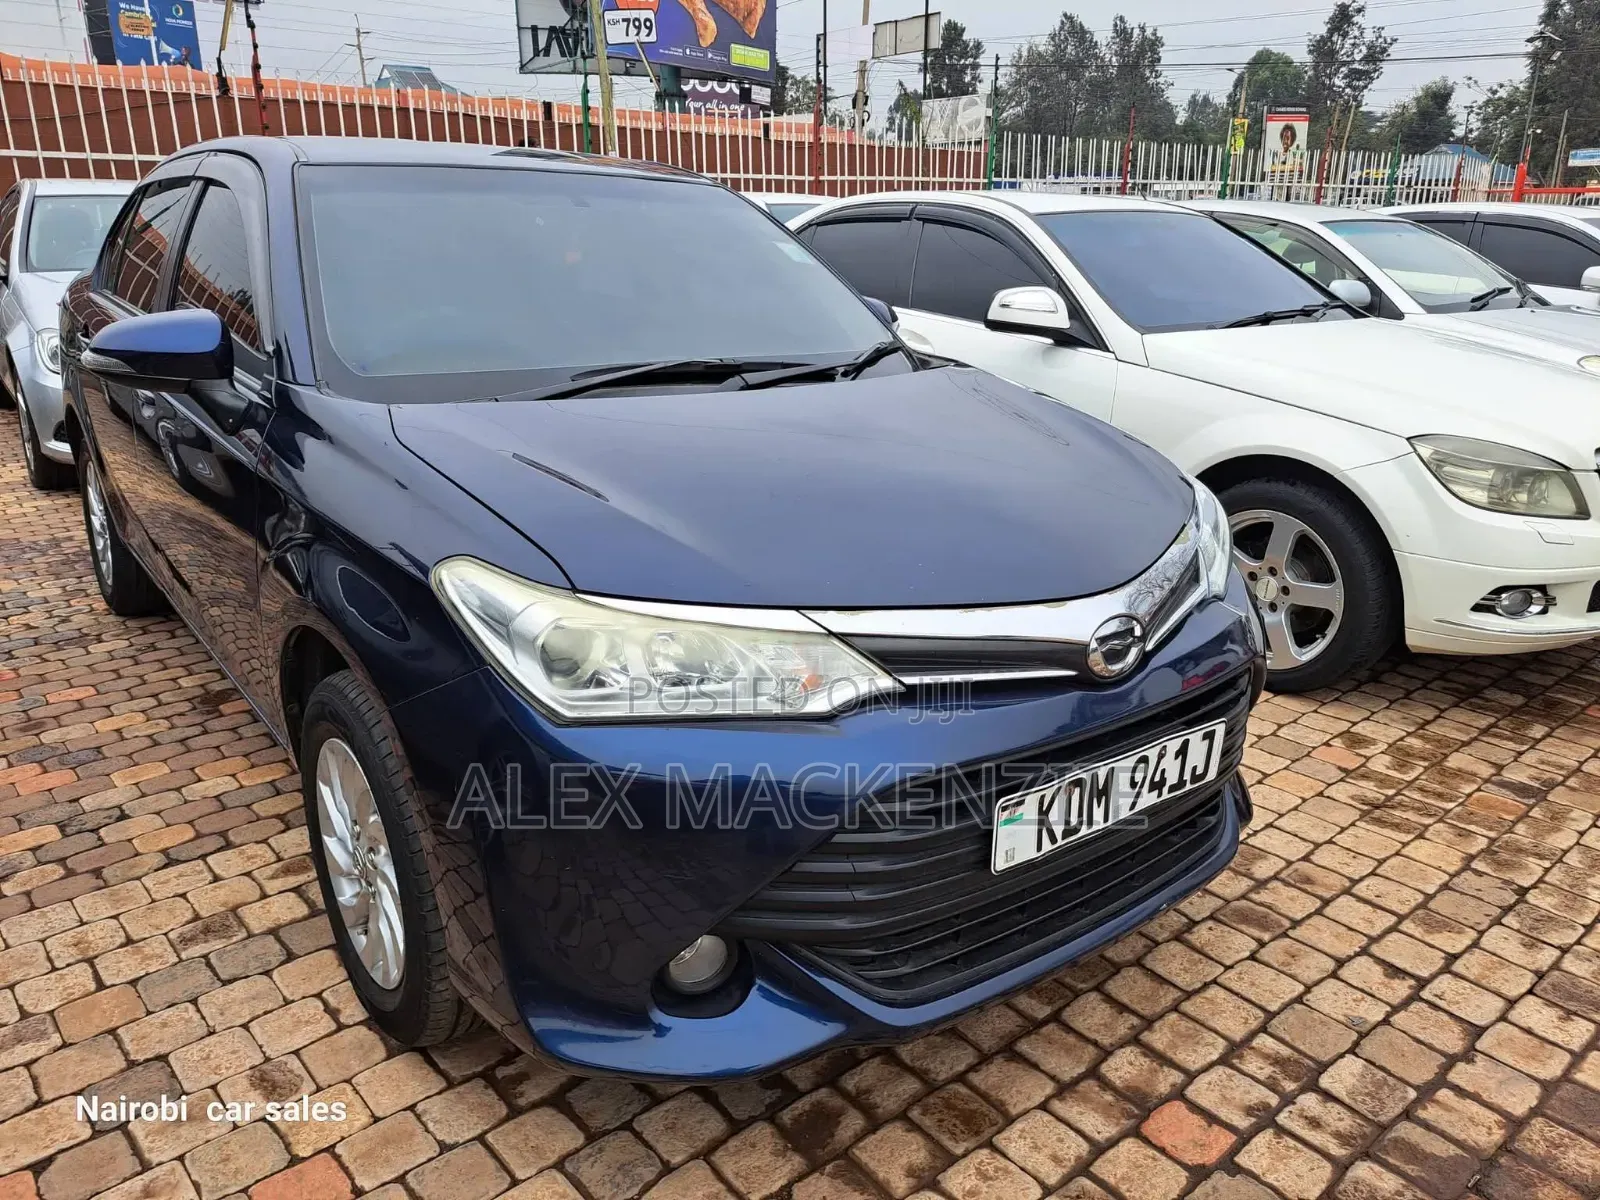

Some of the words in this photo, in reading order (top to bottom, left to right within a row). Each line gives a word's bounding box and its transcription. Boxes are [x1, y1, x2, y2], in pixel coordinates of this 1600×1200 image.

[606, 18, 620, 26] KSH
[621, 16, 654, 38] 799
[1036, 766, 1116, 852] KDM
[1129, 729, 1216, 812] 941J
